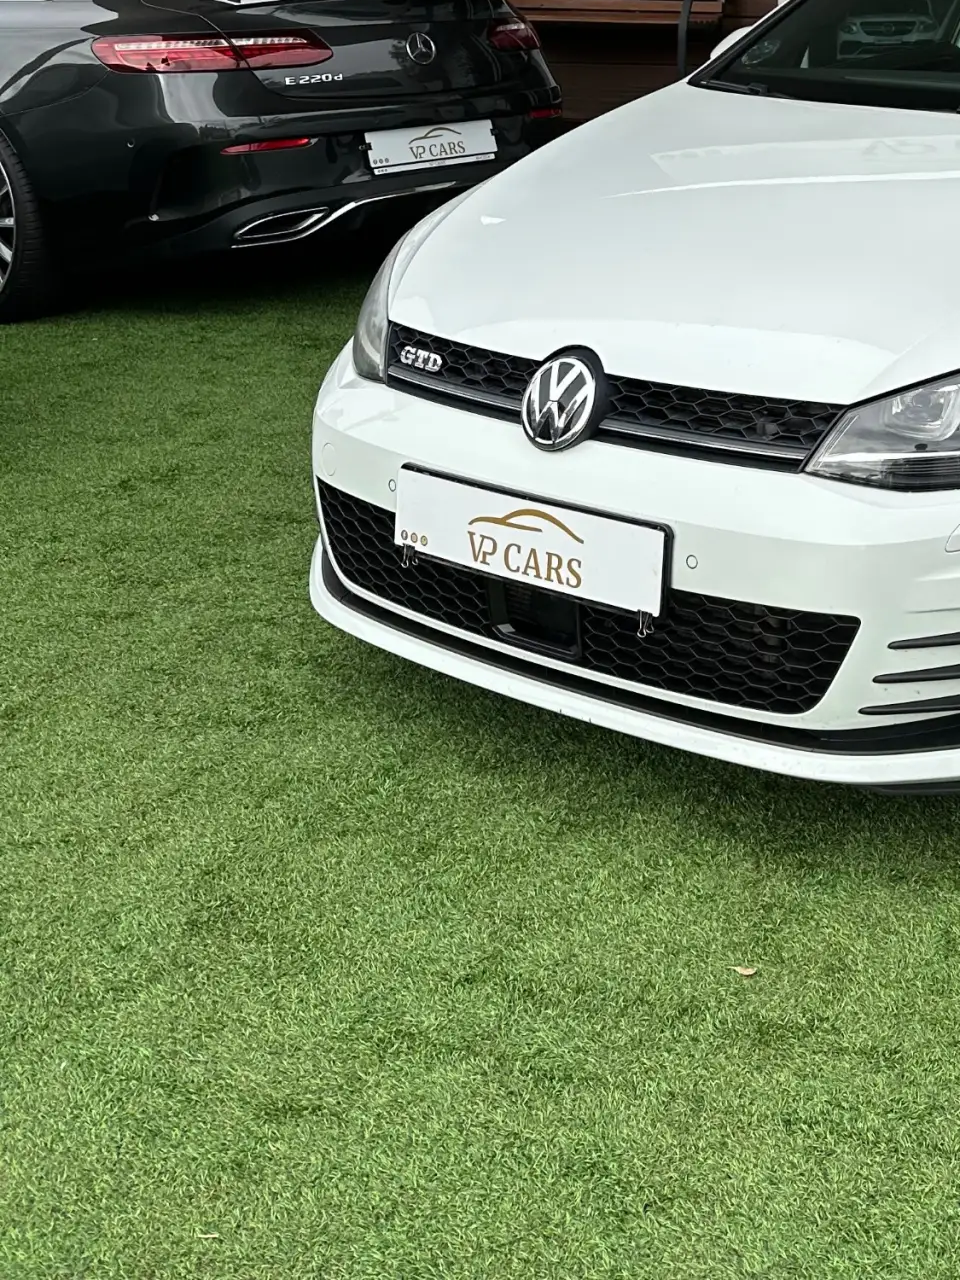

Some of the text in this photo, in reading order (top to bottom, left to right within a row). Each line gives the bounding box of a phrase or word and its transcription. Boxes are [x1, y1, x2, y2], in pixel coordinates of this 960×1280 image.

[285, 76, 297, 86] E
[409, 141, 466, 160] VP CARS
[400, 345, 443, 373] GTD
[467, 530, 582, 589] VP CARS
